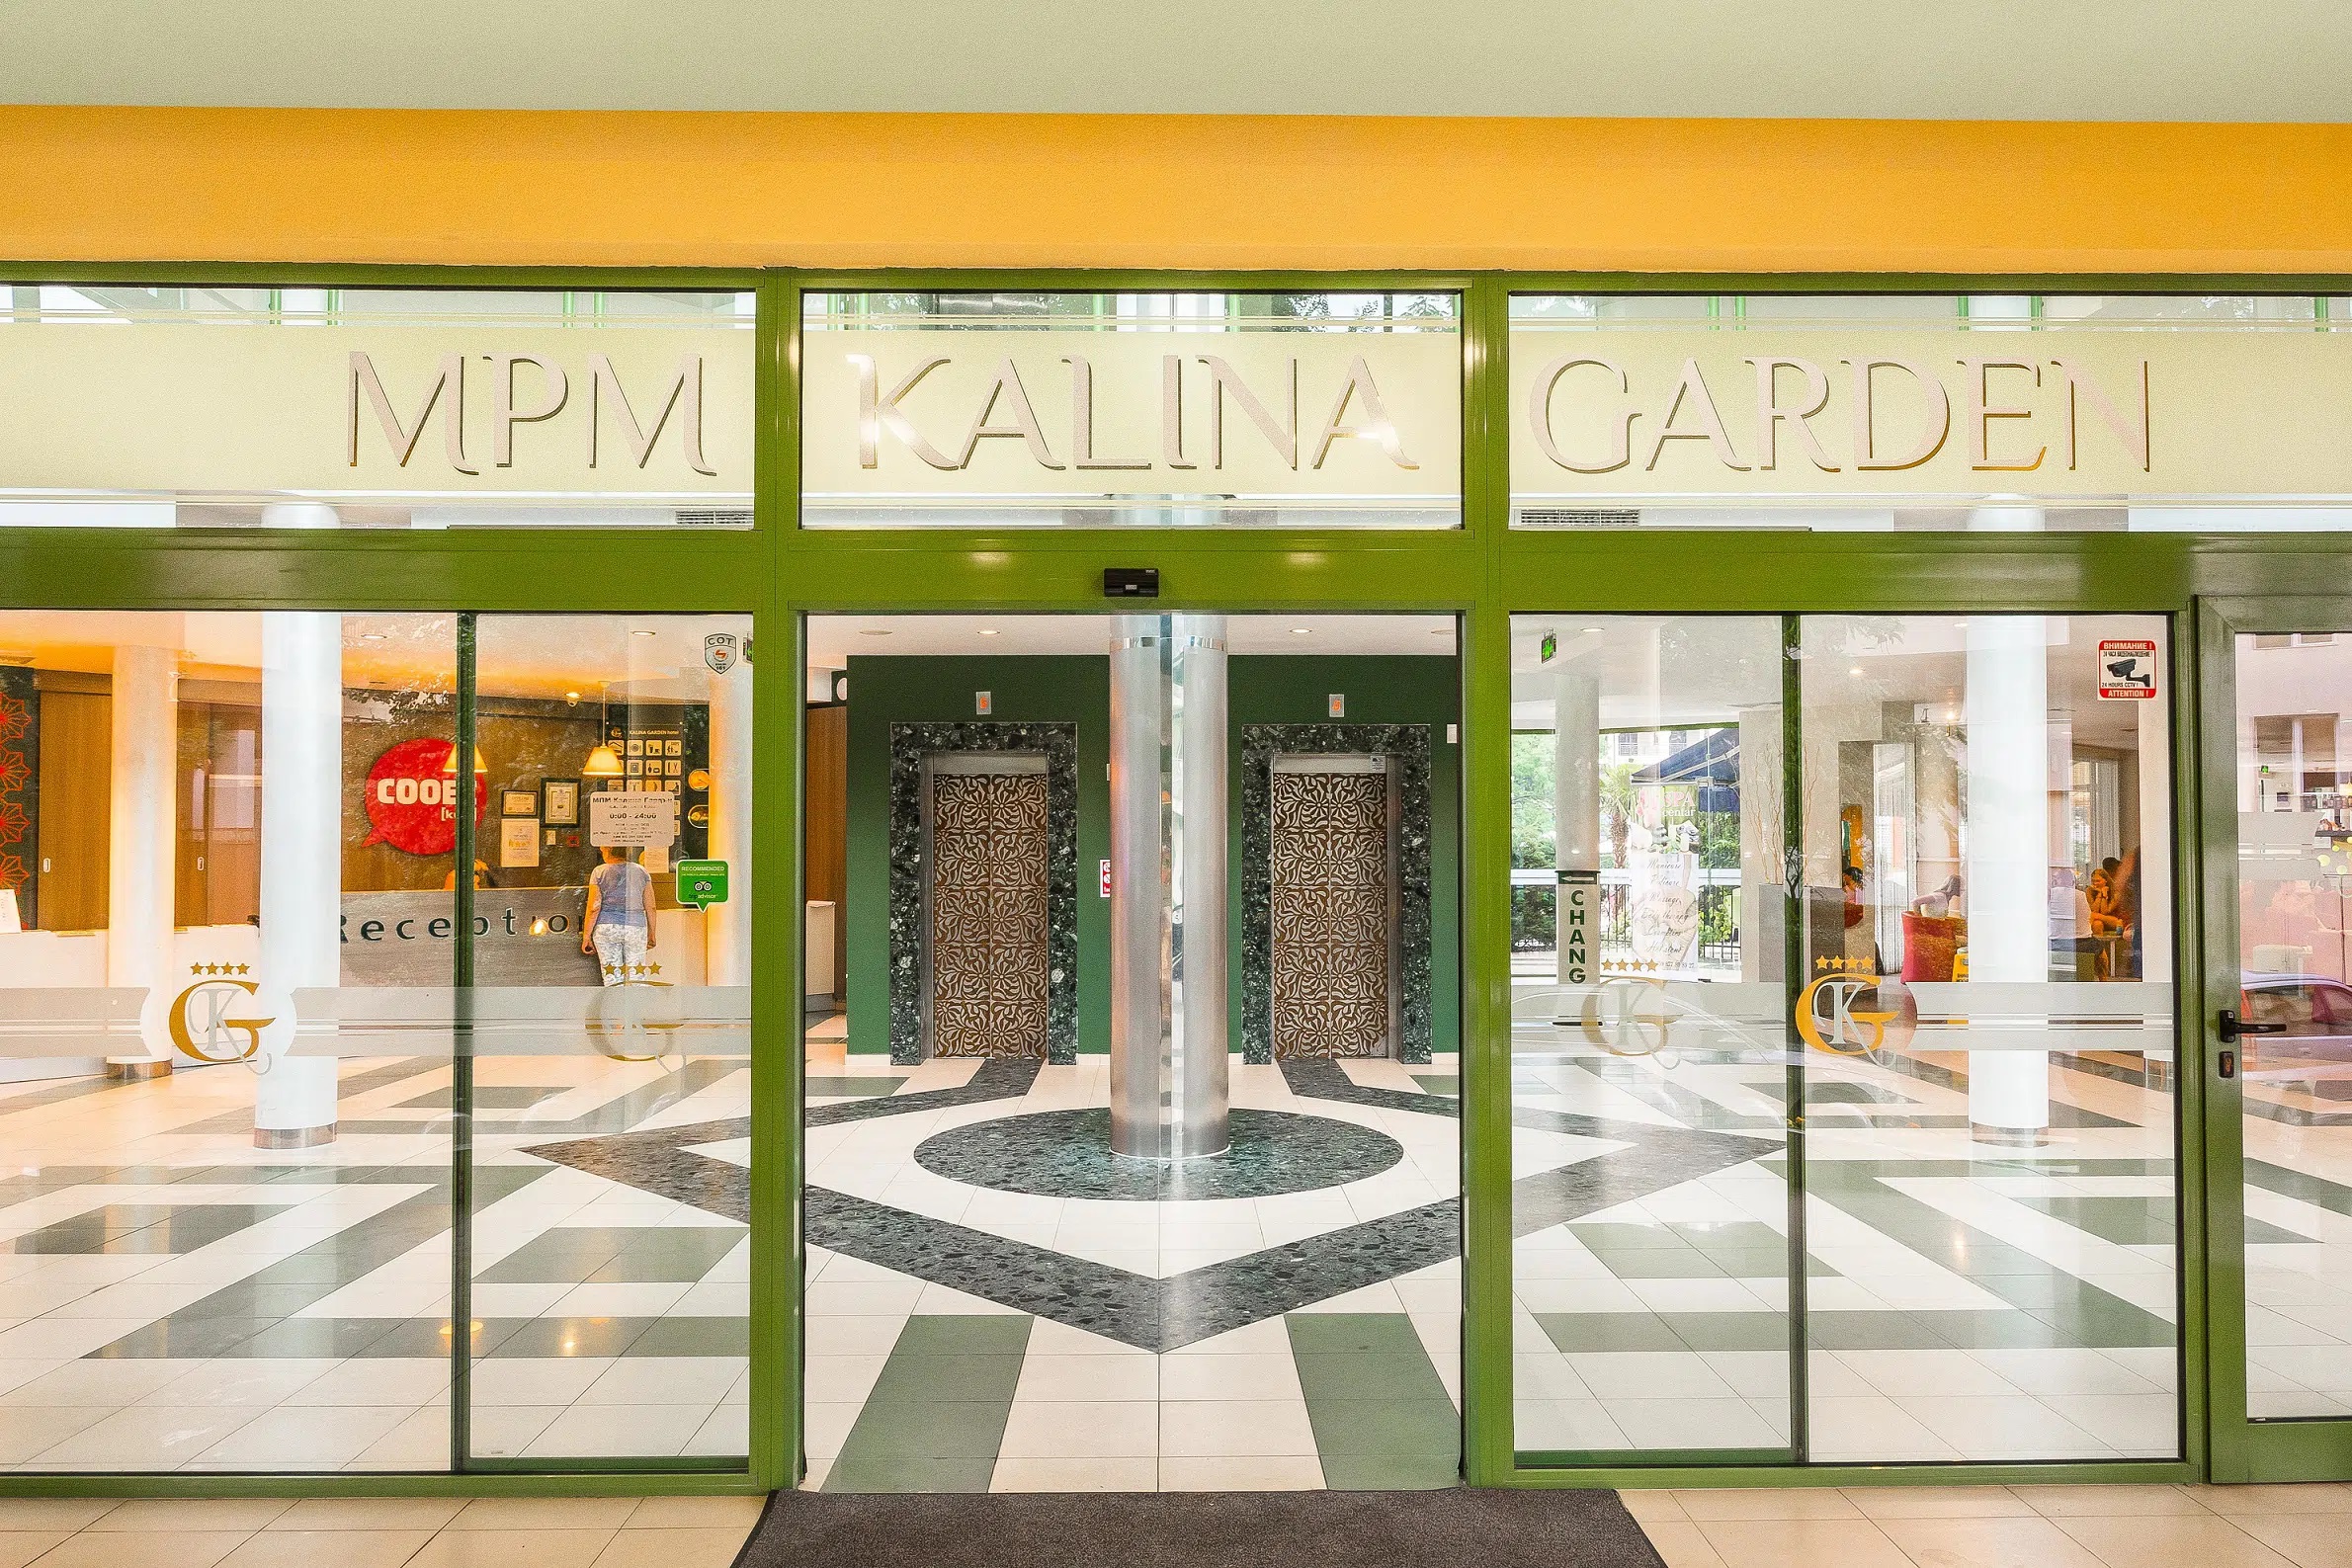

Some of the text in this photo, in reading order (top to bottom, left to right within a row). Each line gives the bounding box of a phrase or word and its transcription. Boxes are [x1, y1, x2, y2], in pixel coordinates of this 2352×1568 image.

[347, 351, 2150, 477] MPM KALINA GARDEN
[708, 636, 733, 645] COT
[377, 778, 477, 805] COOE
[1661, 791, 1696, 808] SPA
